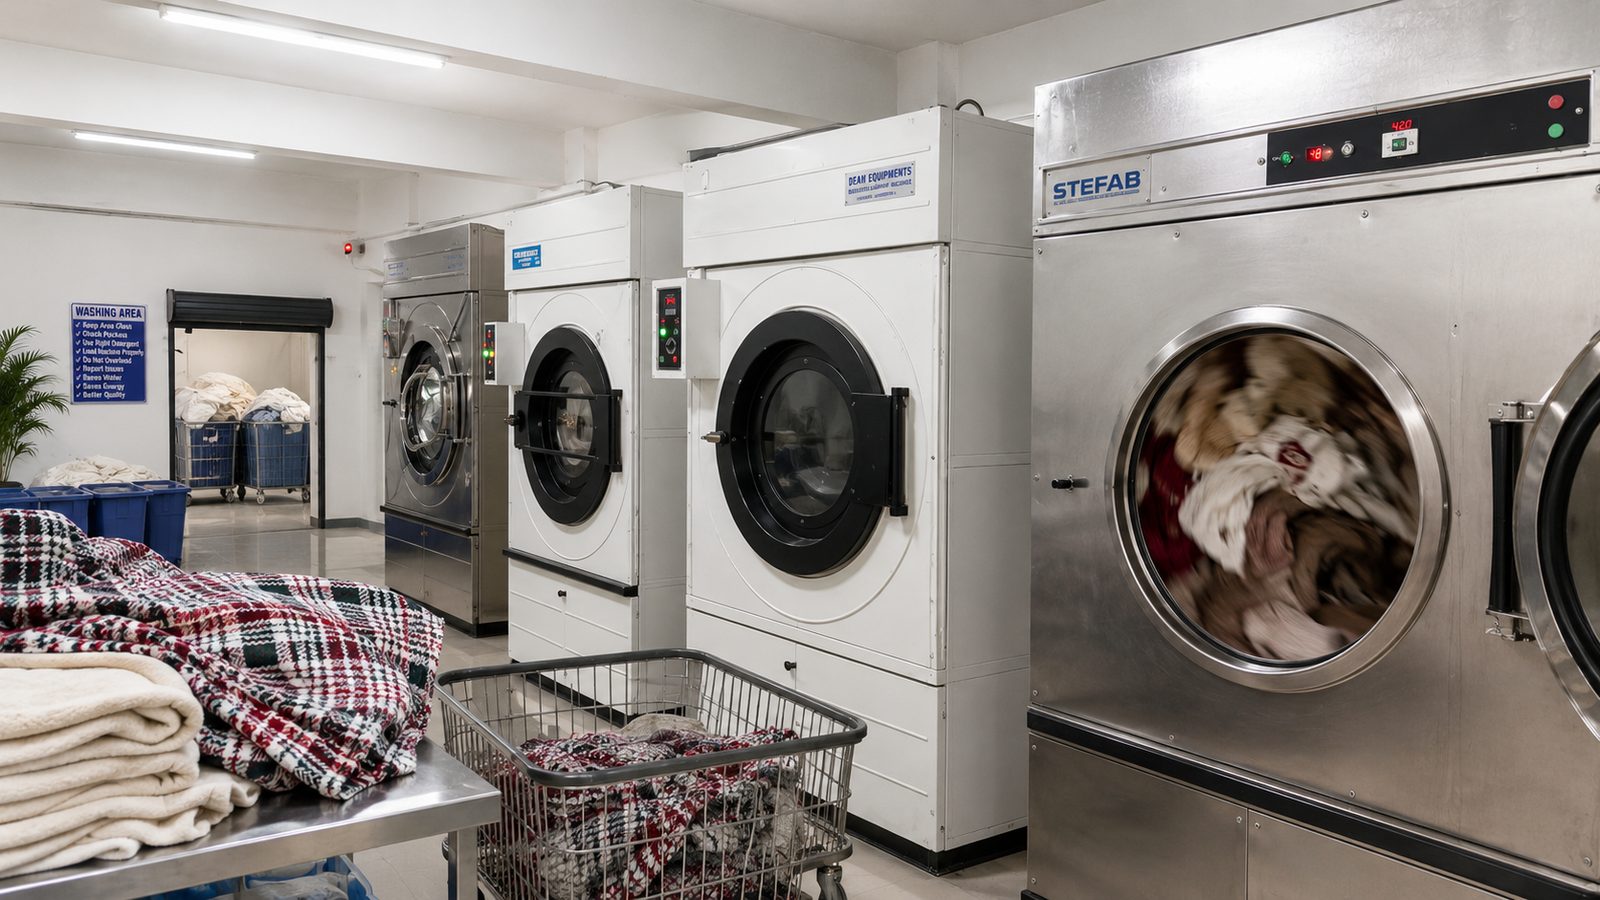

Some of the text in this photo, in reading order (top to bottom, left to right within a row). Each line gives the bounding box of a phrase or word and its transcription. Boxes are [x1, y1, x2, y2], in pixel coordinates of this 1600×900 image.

[1053, 170, 1141, 200] STEFAB
[75, 306, 142, 318] WASHING AREA
